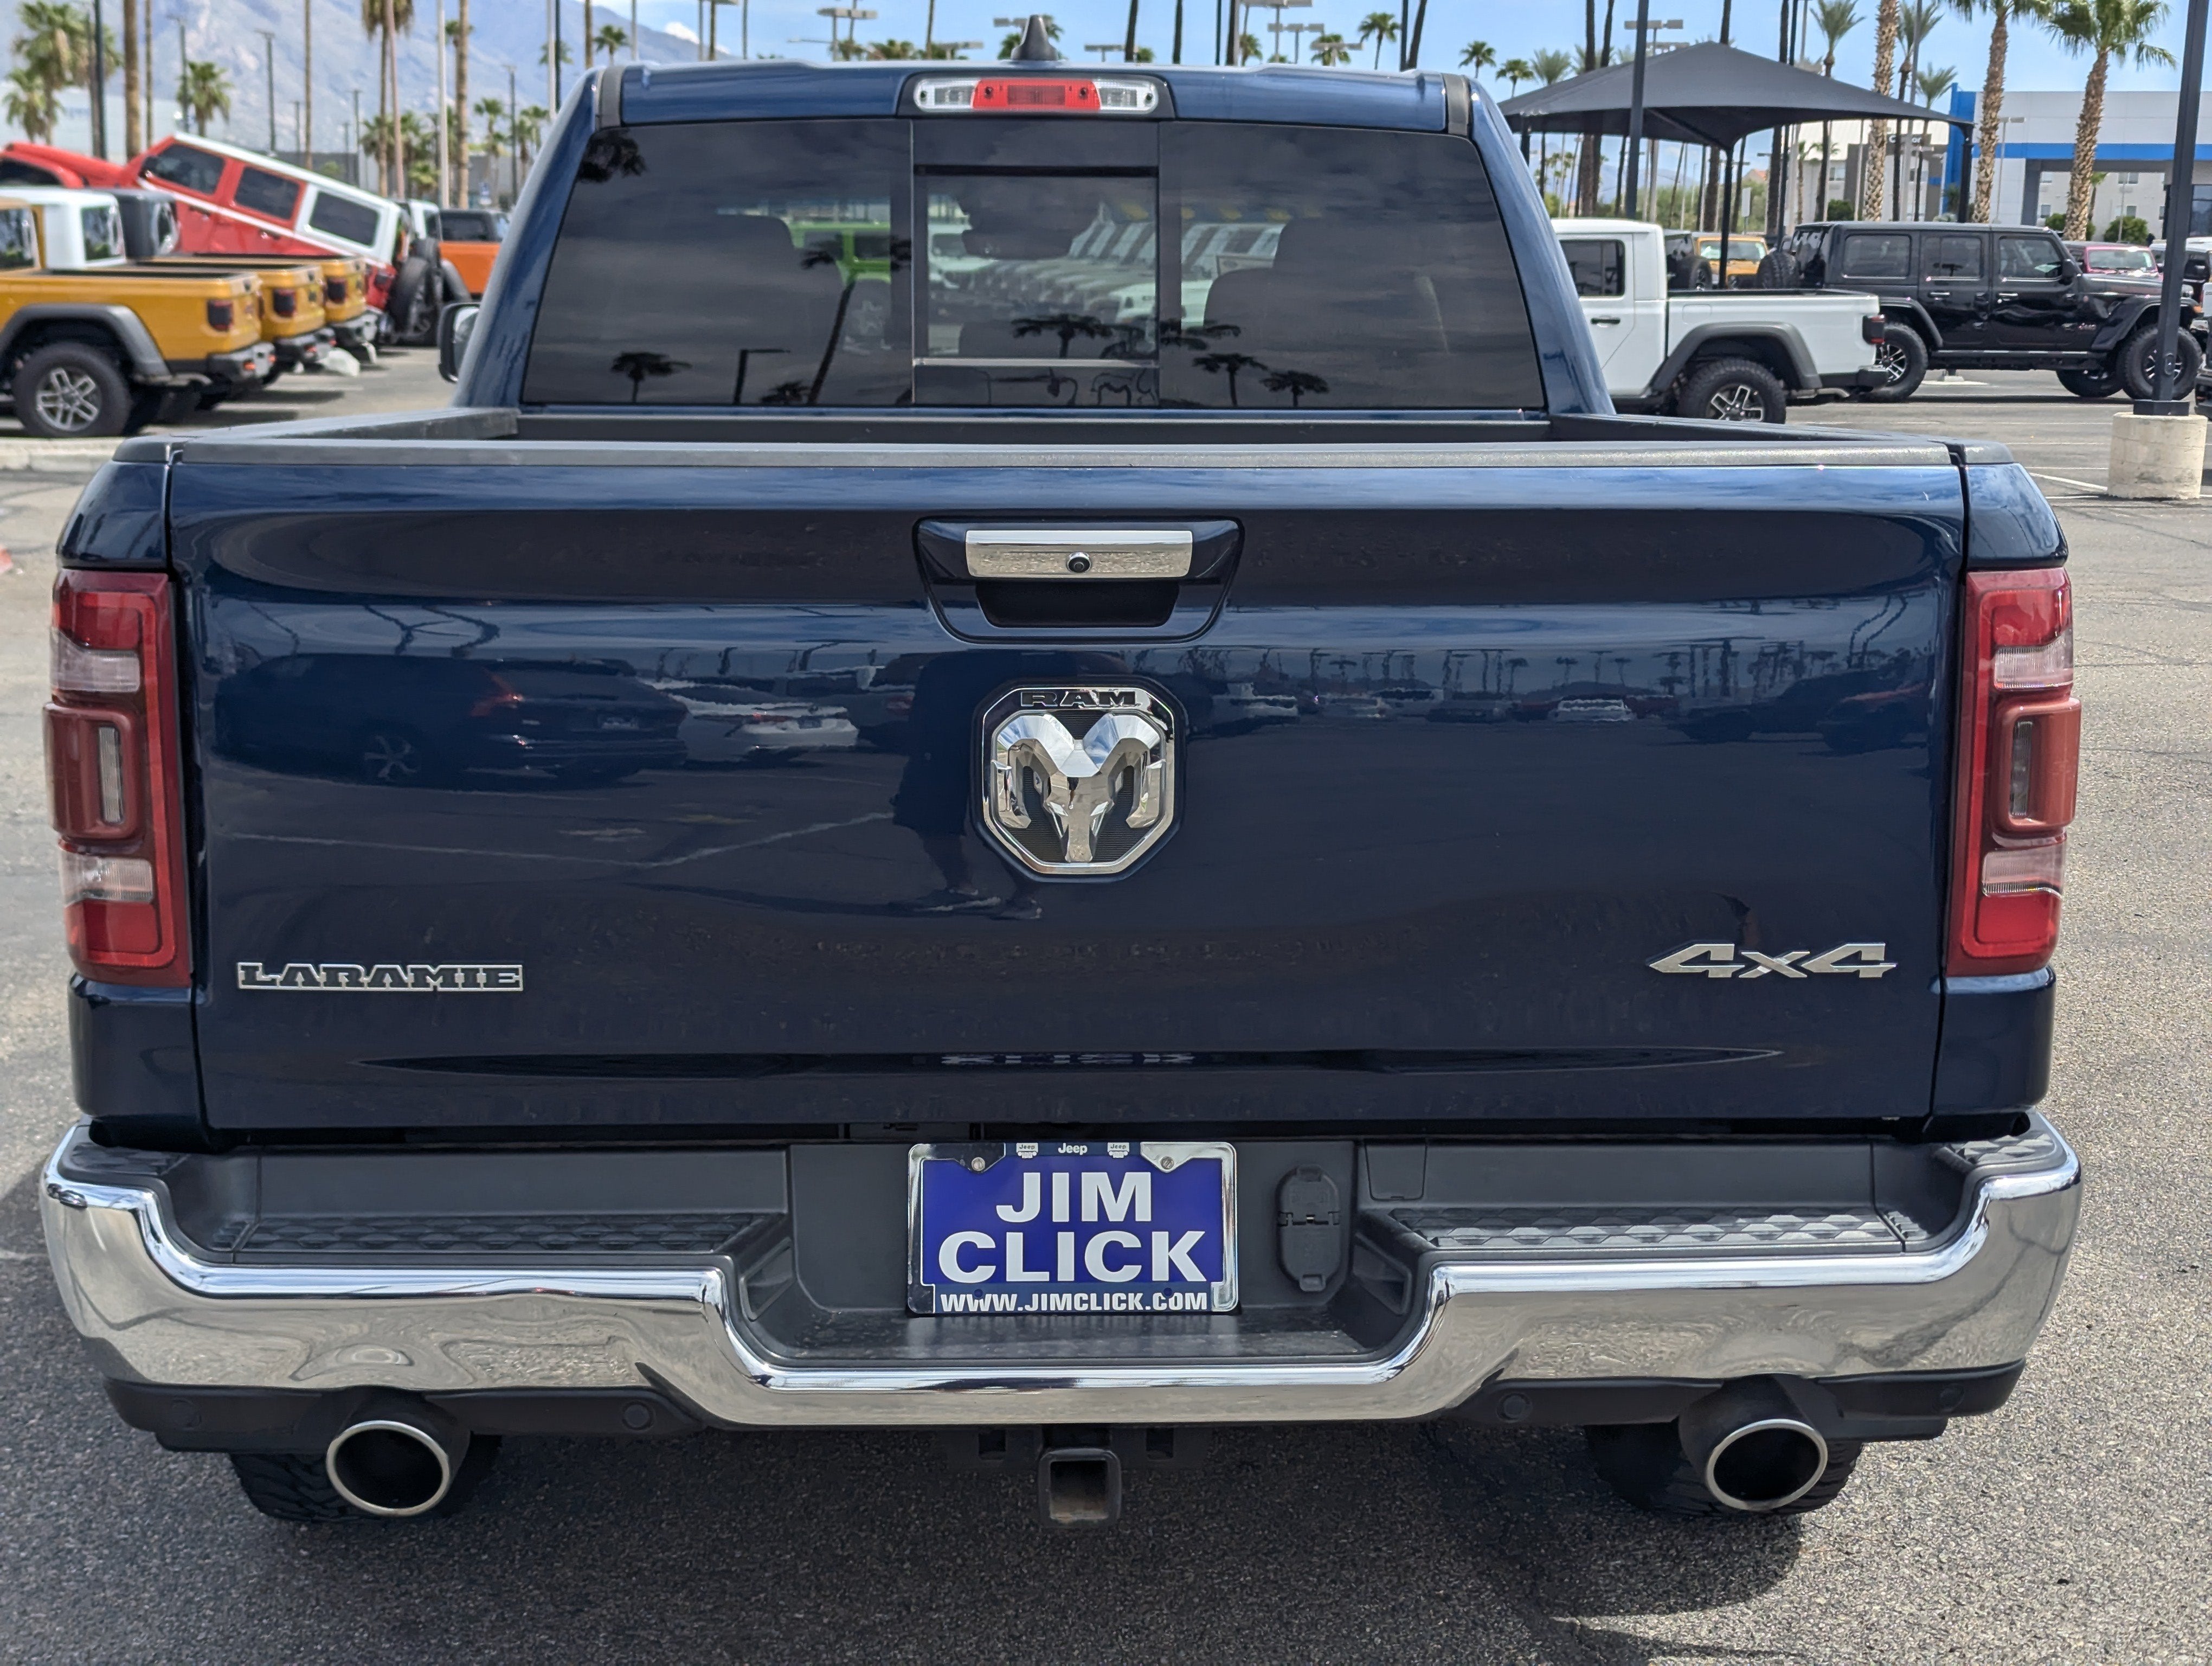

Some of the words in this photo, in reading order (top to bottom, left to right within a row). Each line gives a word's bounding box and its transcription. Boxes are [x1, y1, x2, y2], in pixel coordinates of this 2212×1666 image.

[1020, 691, 1142, 707] RAM
[237, 962, 524, 991] LARAMIE
[1058, 1143, 1088, 1155] Jeep
[996, 1172, 1152, 1222] JIM
[938, 1231, 1207, 1282] CLICK
[940, 1292, 1207, 1312] WWW.JIMCLICK.COM
